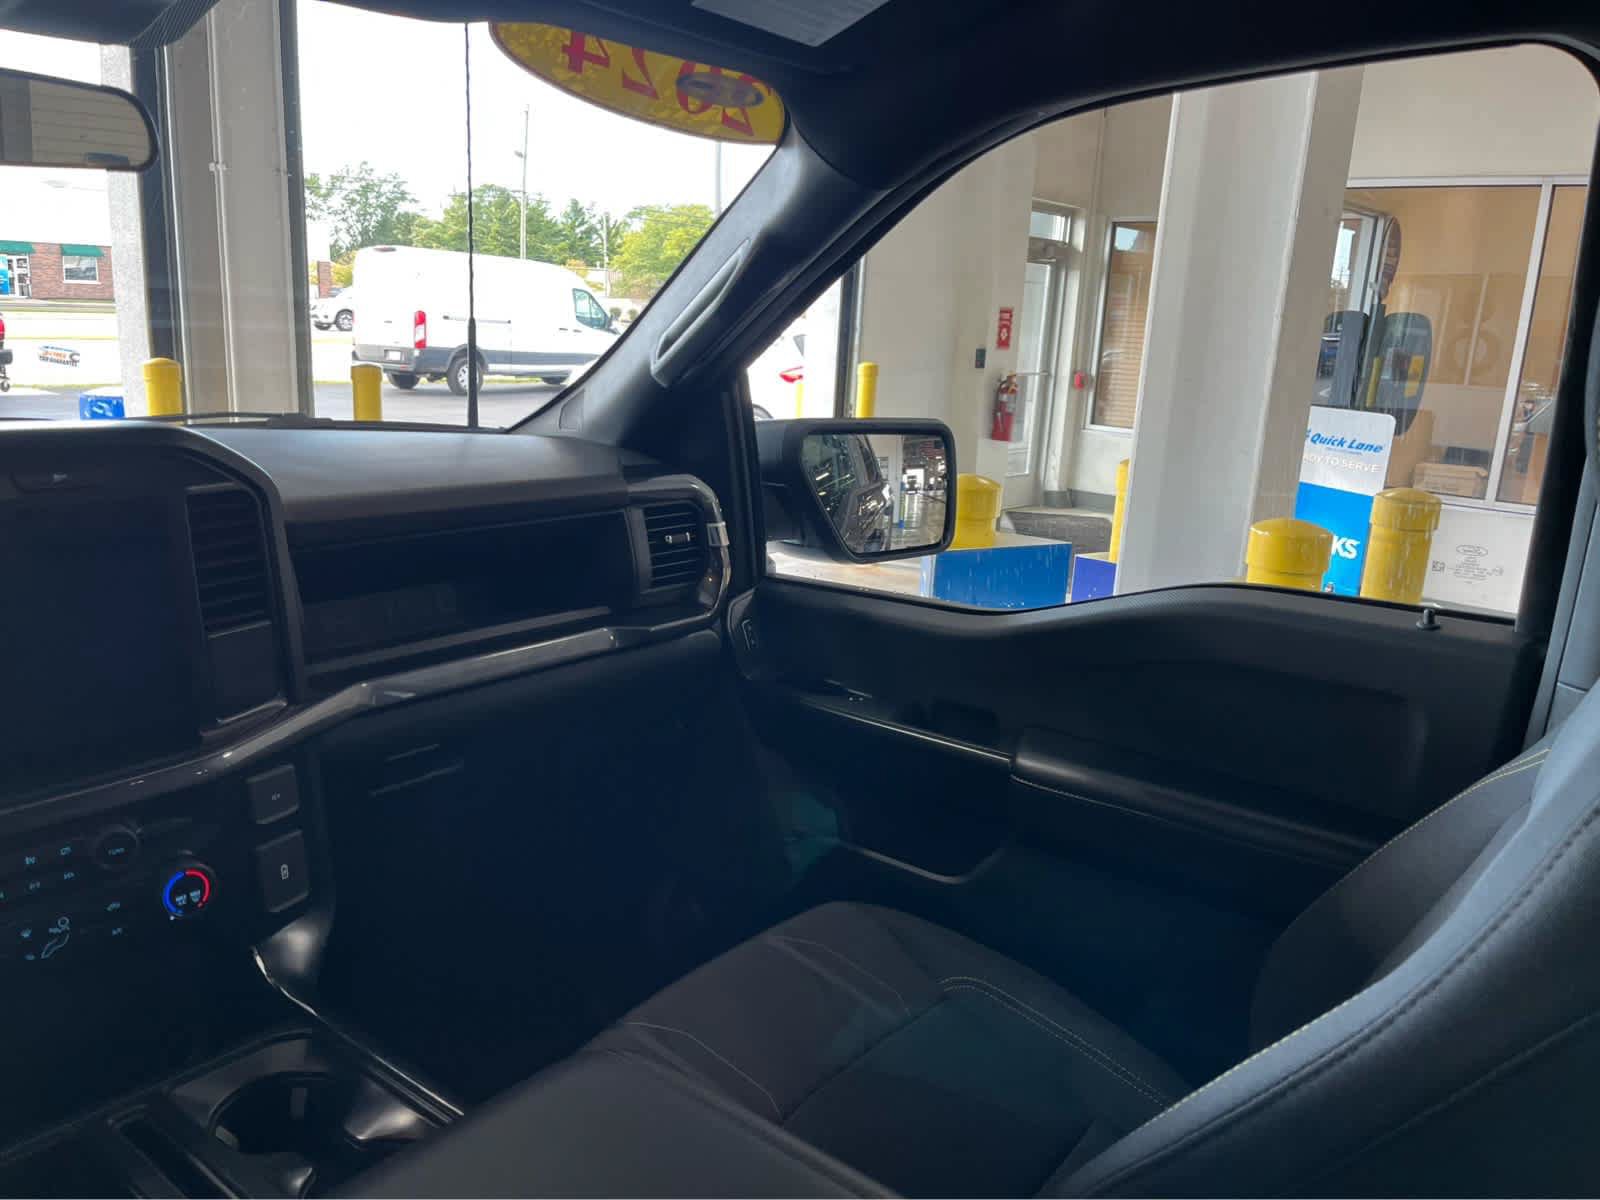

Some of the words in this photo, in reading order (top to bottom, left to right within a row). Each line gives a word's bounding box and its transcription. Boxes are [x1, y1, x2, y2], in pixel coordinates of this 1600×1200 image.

[1310, 432, 1346, 447] Quick
[1347, 439, 1383, 452] Lane
[1342, 458, 1381, 473] SERVE
